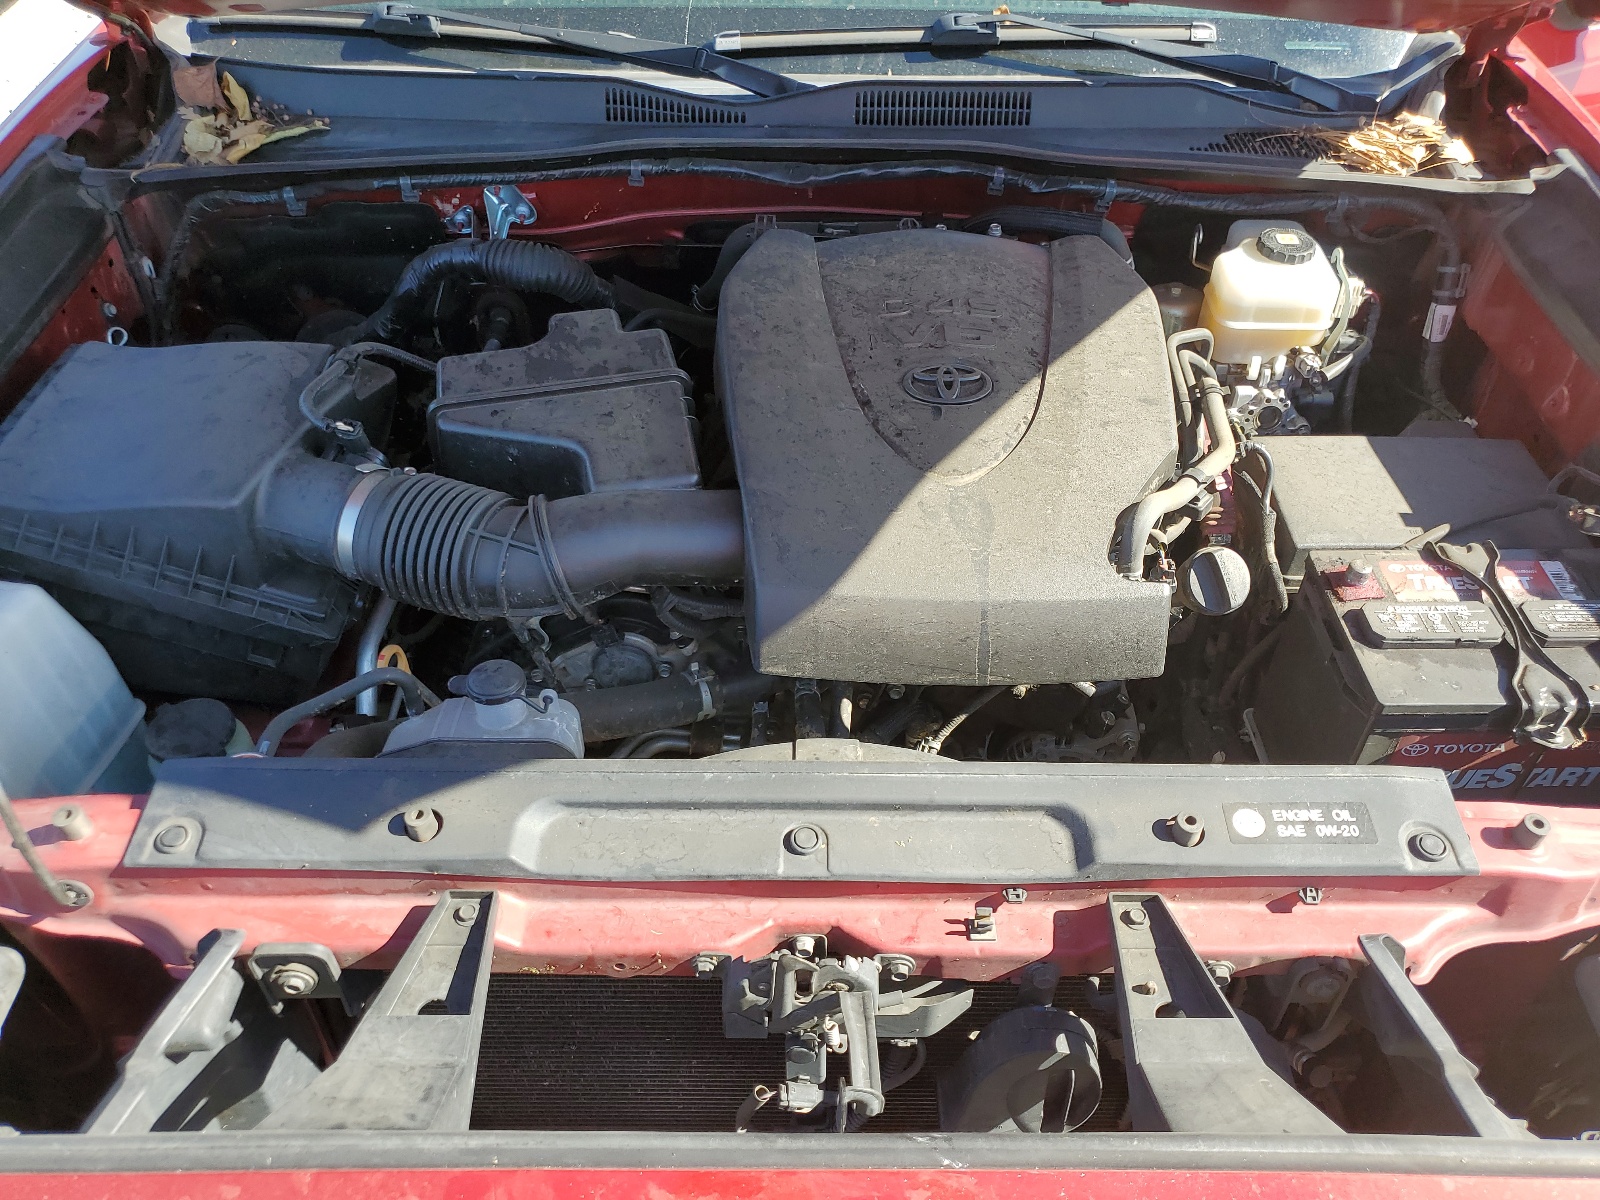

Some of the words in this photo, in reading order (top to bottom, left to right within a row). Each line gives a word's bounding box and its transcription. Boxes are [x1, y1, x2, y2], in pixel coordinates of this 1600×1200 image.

[1405, 563, 1453, 572] TOYOTA
[1433, 742, 1506, 754] TOYOTA
[1271, 809, 1325, 822] ENGINE
[1331, 809, 1357, 822] OIL
[1276, 824, 1307, 838] SAE
[1315, 824, 1360, 838] 0W-20
